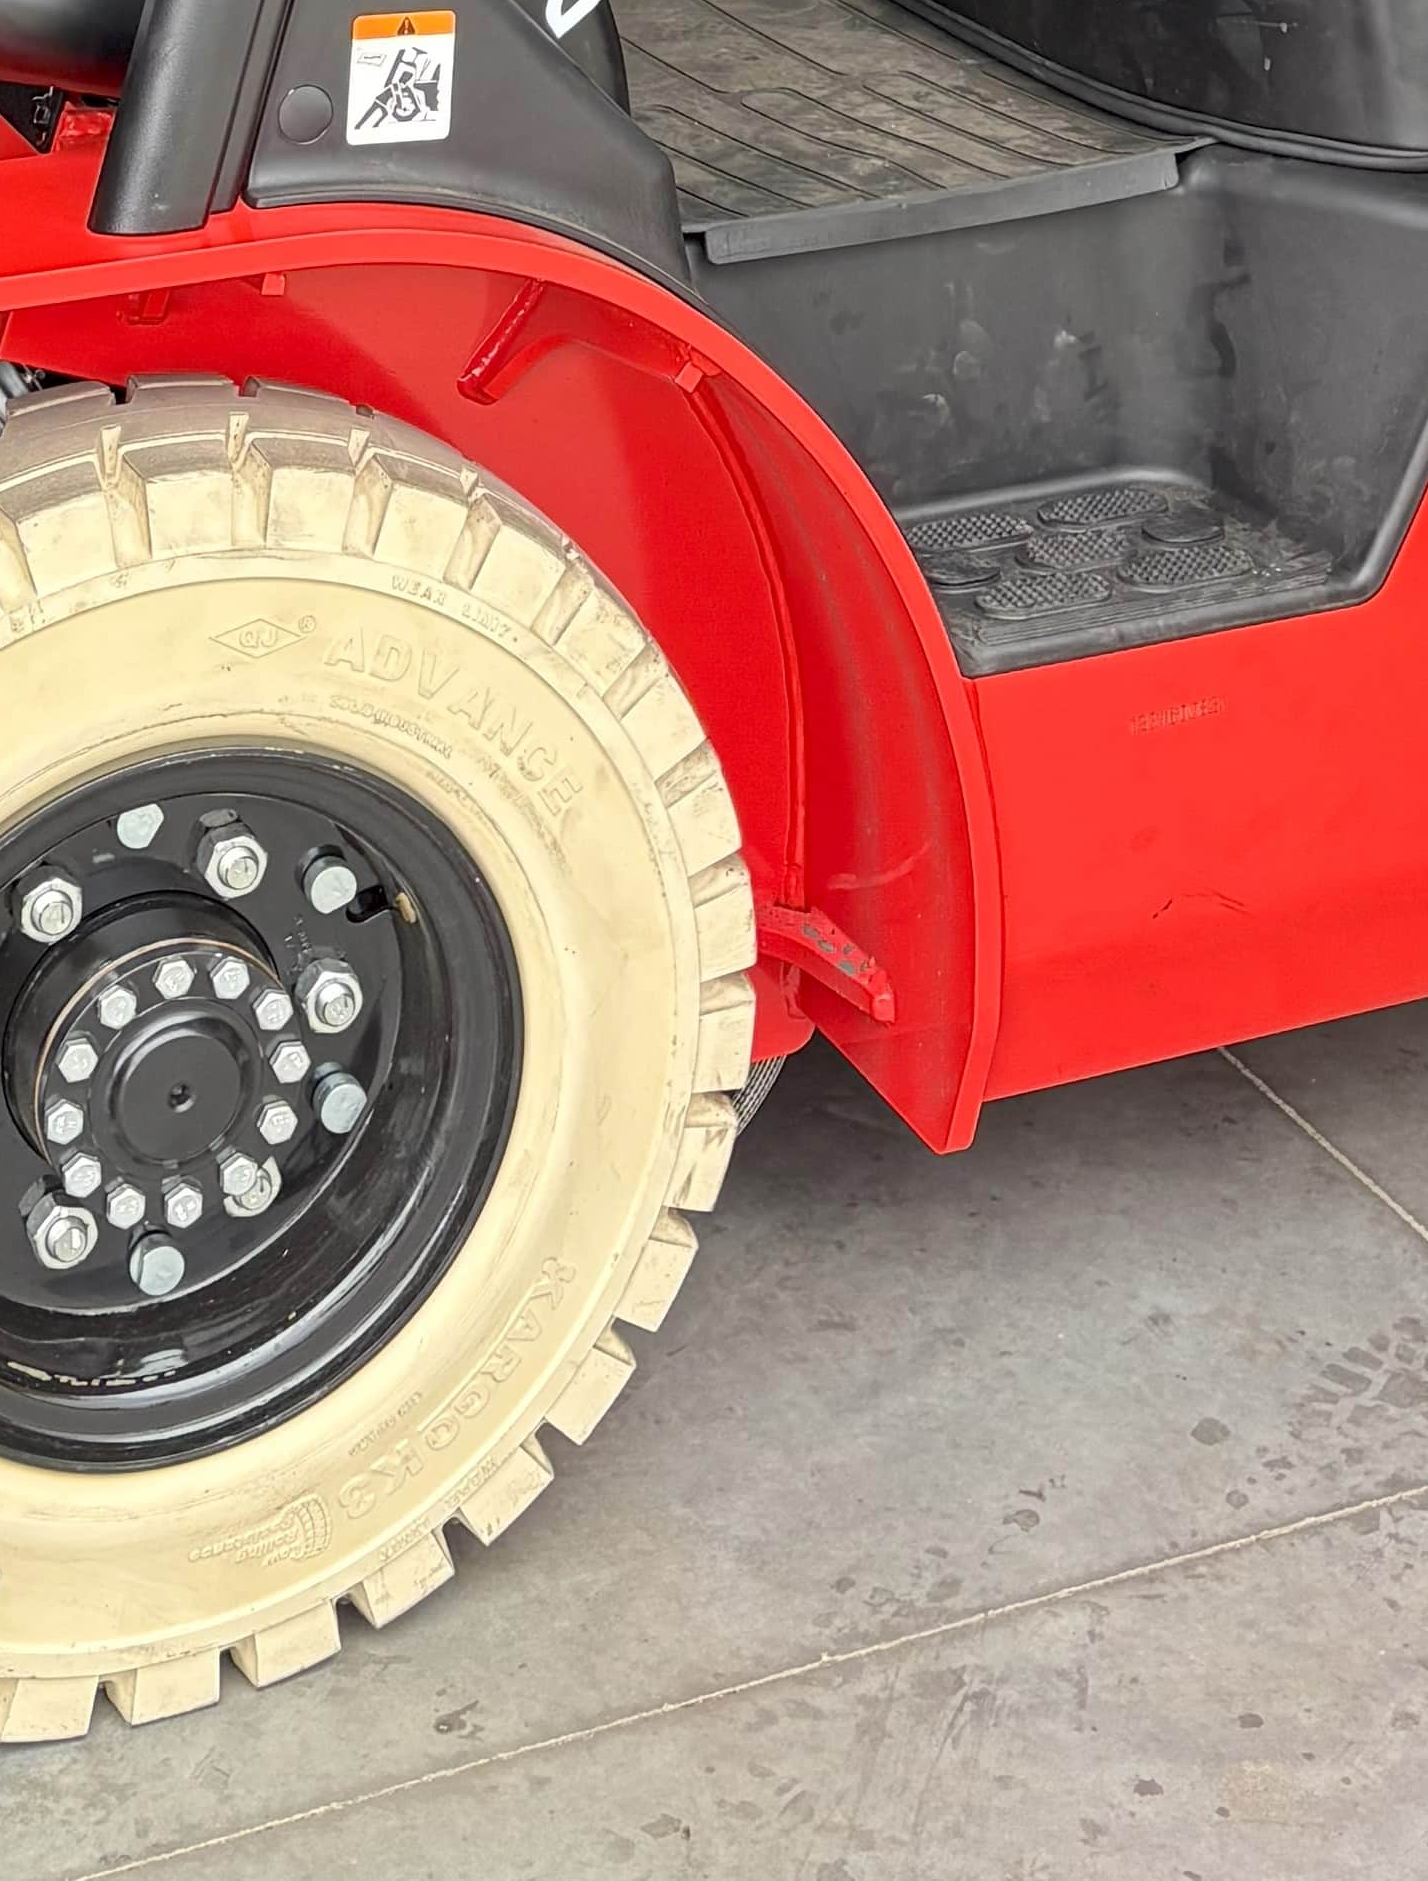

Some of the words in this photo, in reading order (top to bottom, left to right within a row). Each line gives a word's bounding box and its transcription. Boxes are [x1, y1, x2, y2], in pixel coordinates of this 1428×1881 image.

[392, 574, 447, 607] WEAR
[324, 628, 584, 818] ADVANCE
[424, 1256, 576, 1451] KARGO
